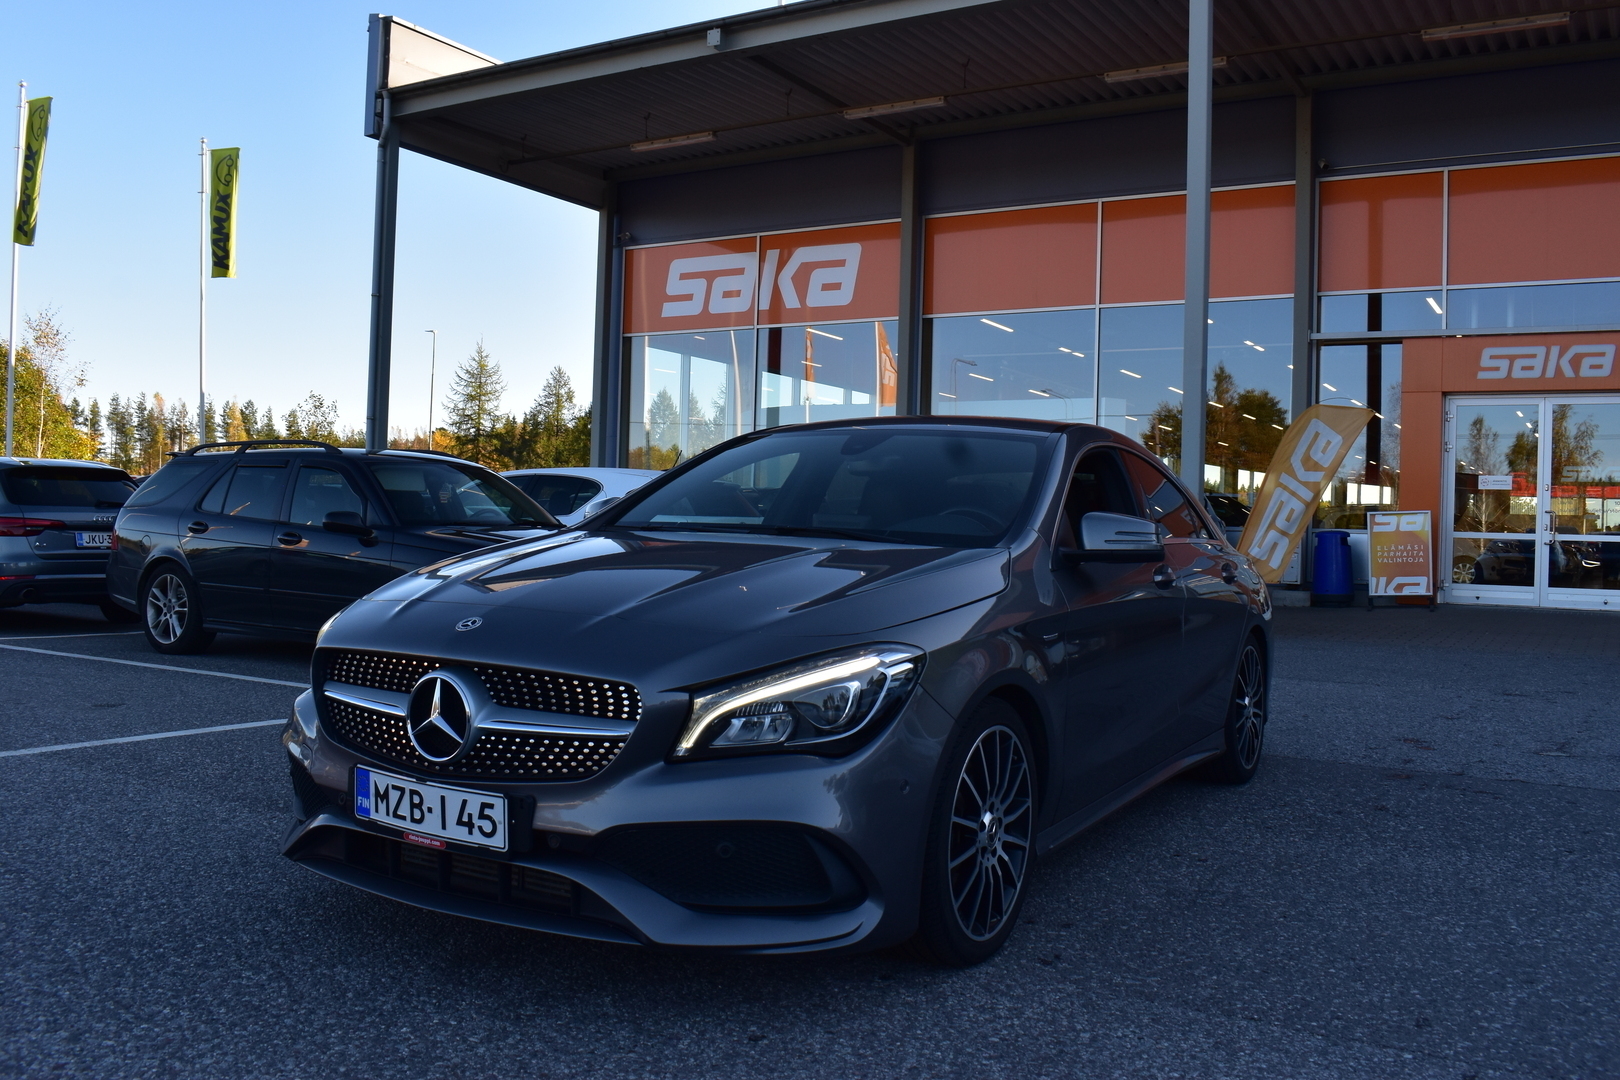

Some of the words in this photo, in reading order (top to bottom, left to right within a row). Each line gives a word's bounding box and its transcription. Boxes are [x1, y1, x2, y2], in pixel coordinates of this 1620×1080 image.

[212, 189, 231, 270] KAMUX
[357, 796, 370, 809] FIN
[373, 779, 498, 838] MZB-145
